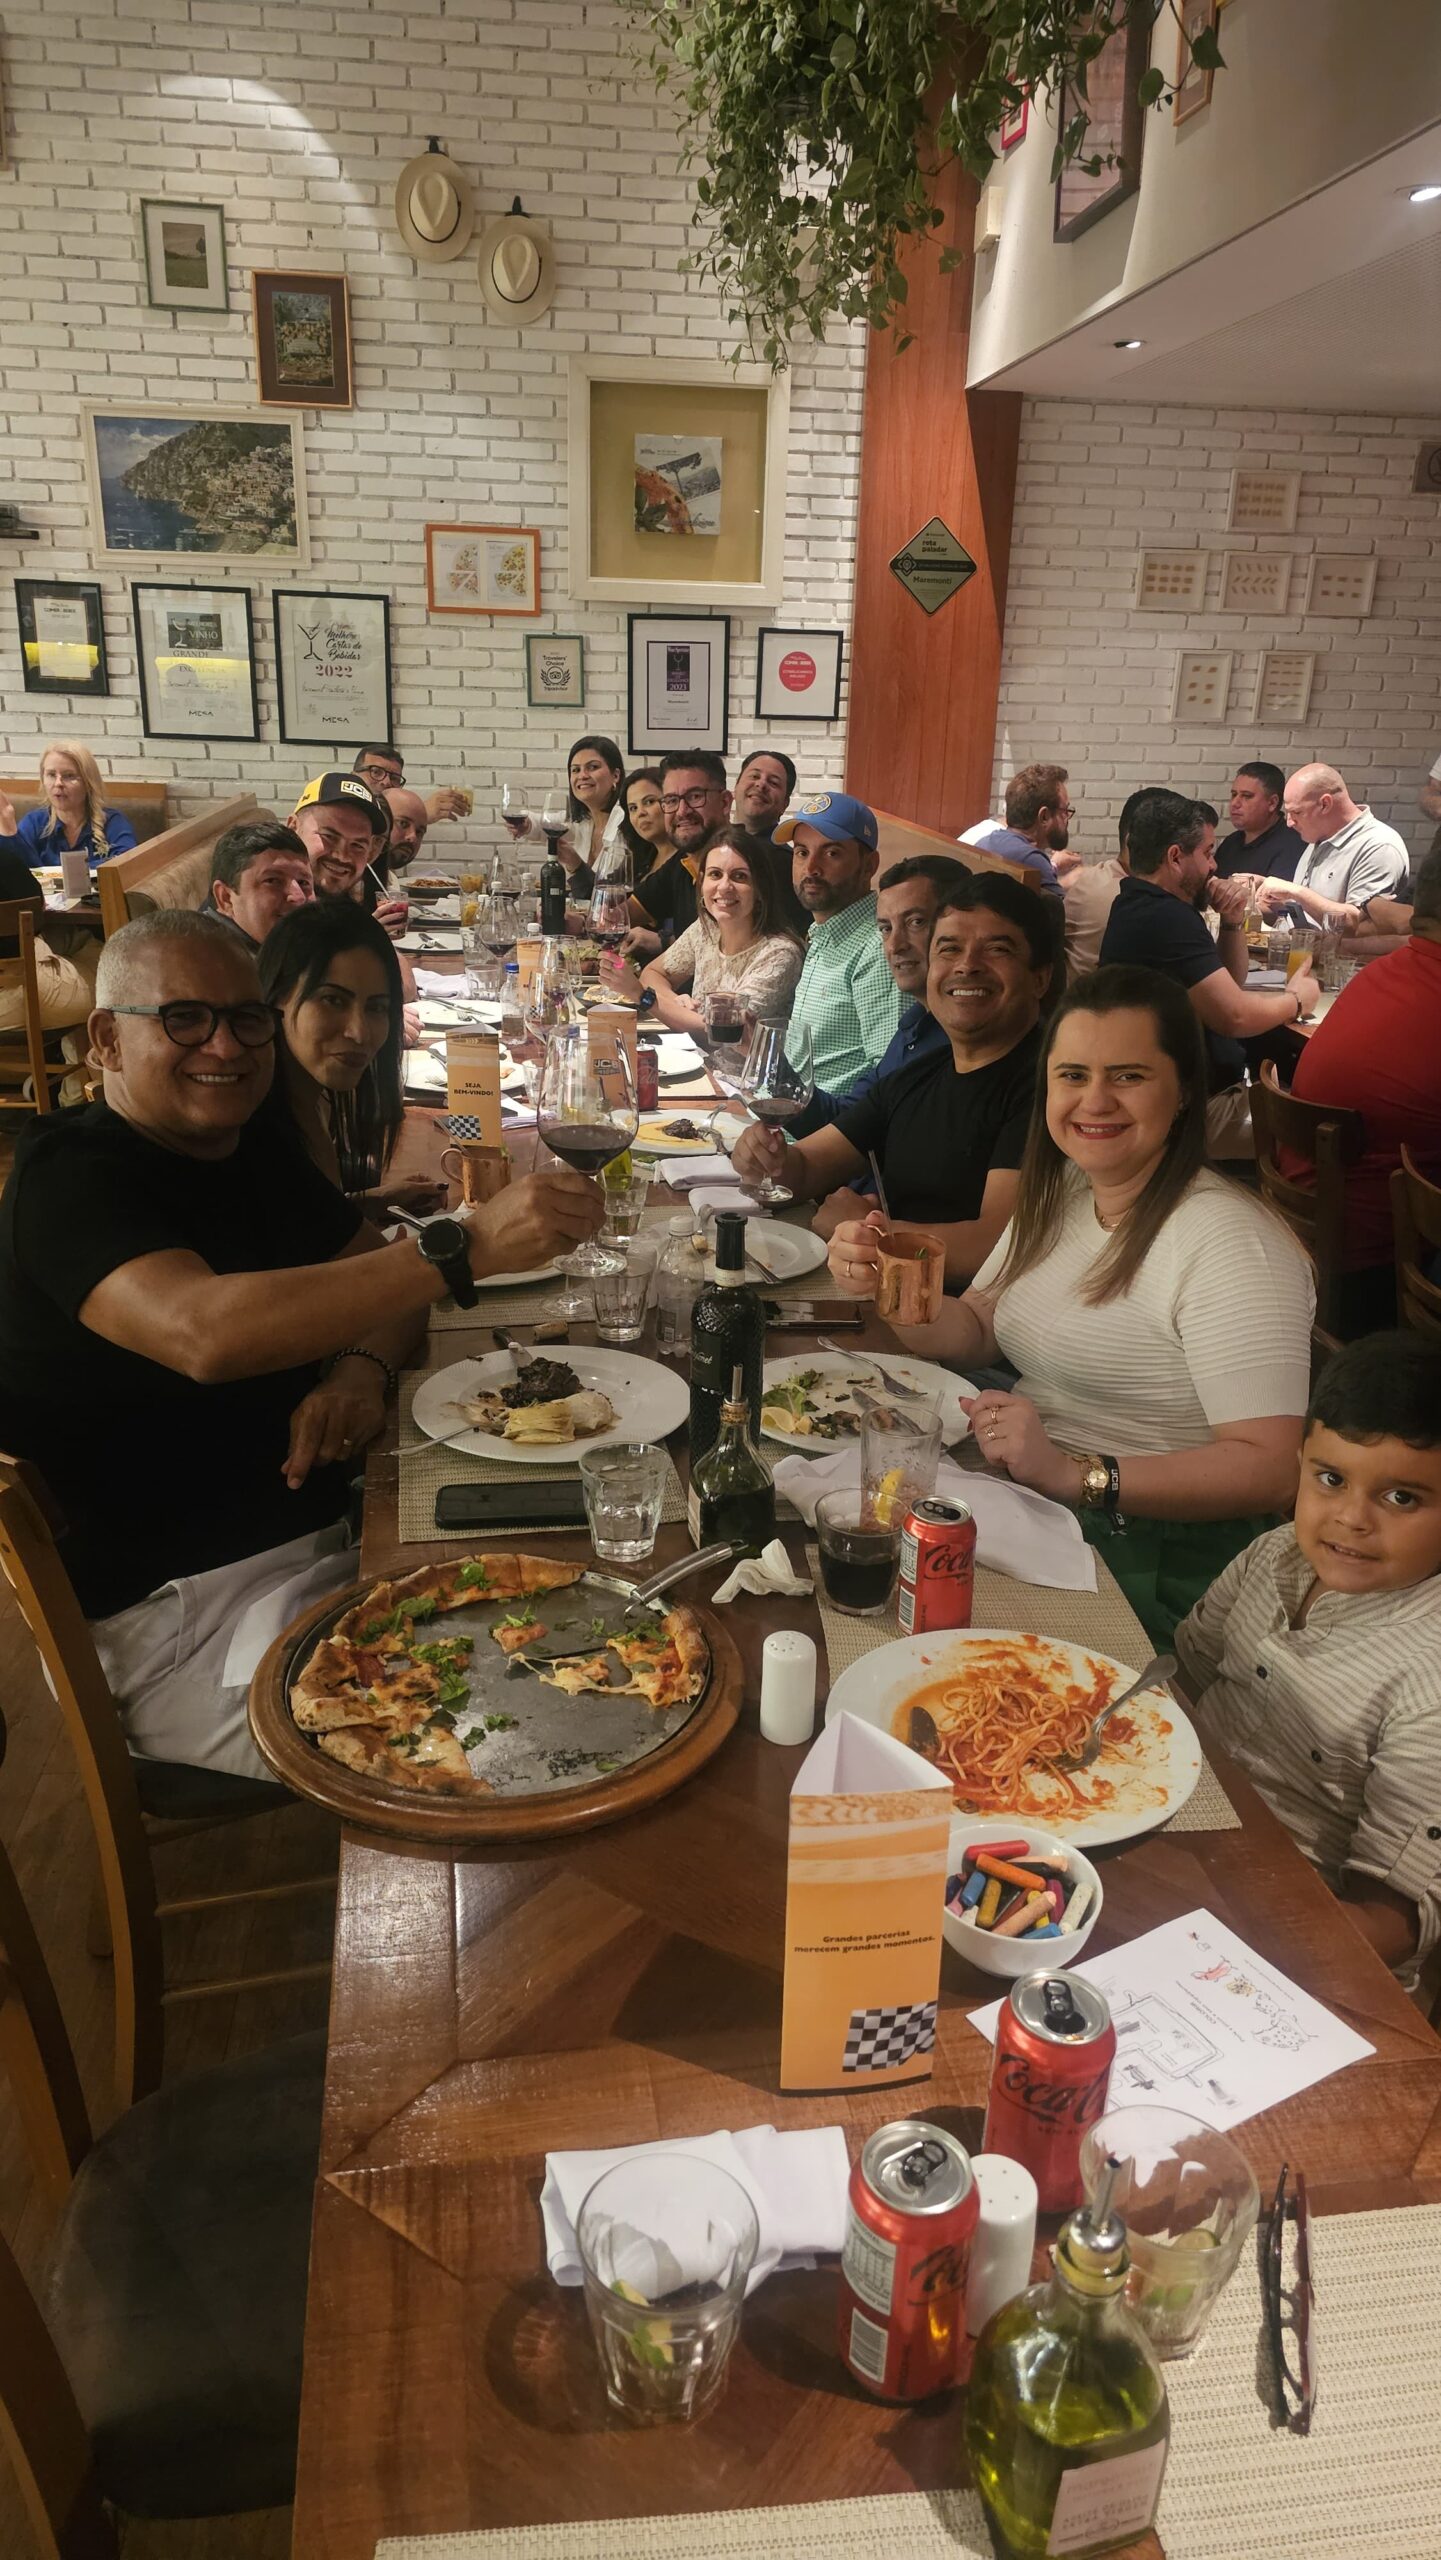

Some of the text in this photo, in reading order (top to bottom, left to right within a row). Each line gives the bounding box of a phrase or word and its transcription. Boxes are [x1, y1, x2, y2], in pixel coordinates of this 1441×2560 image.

[189, 631, 219, 640] VINHO
[315, 664, 353, 678] 2022
[453, 1089, 494, 1097] BEM-VINDO!
[823, 1930, 910, 1943] Grandes parcerias
[794, 1934, 936, 1954] merecem grandes momentos.
